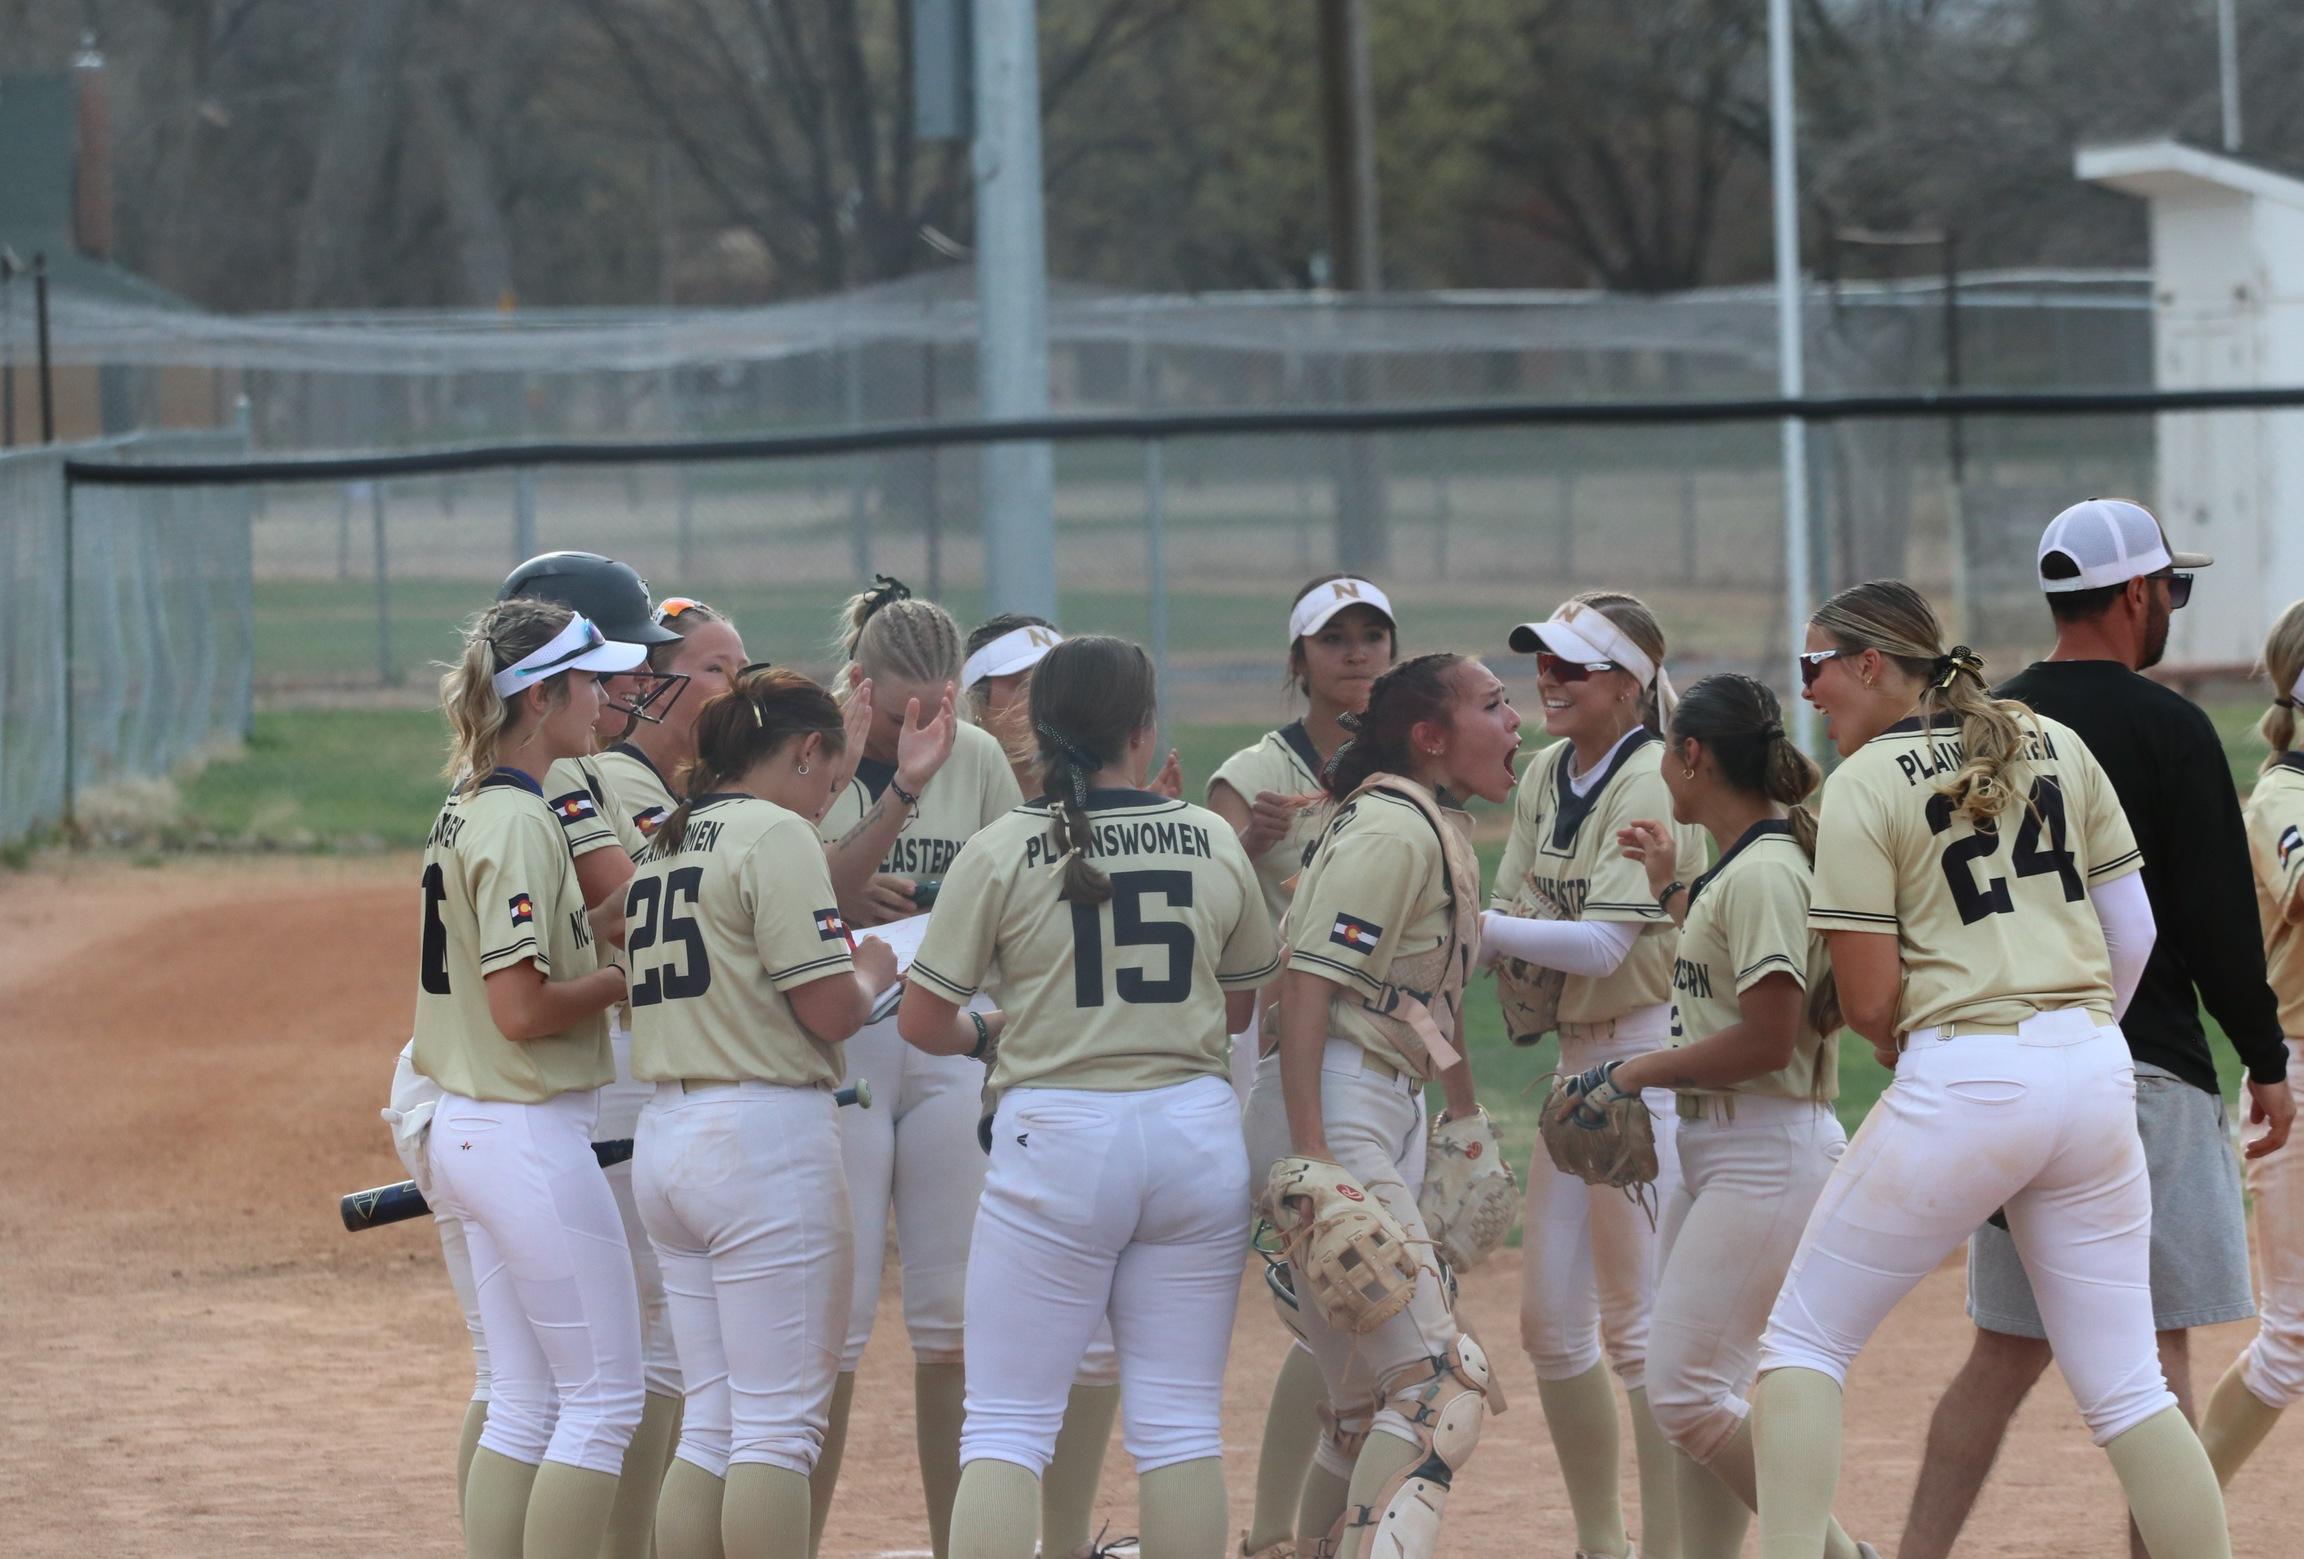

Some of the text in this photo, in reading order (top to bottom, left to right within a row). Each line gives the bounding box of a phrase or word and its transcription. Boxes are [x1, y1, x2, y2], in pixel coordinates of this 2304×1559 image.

[1332, 582, 1361, 600] N
[1027, 629, 1053, 648] N
[1026, 821, 1211, 869] PLNSWOMEN
[1925, 775, 2085, 925] 24
[626, 866, 712, 1008] 25
[1057, 869, 1195, 1008] 15
